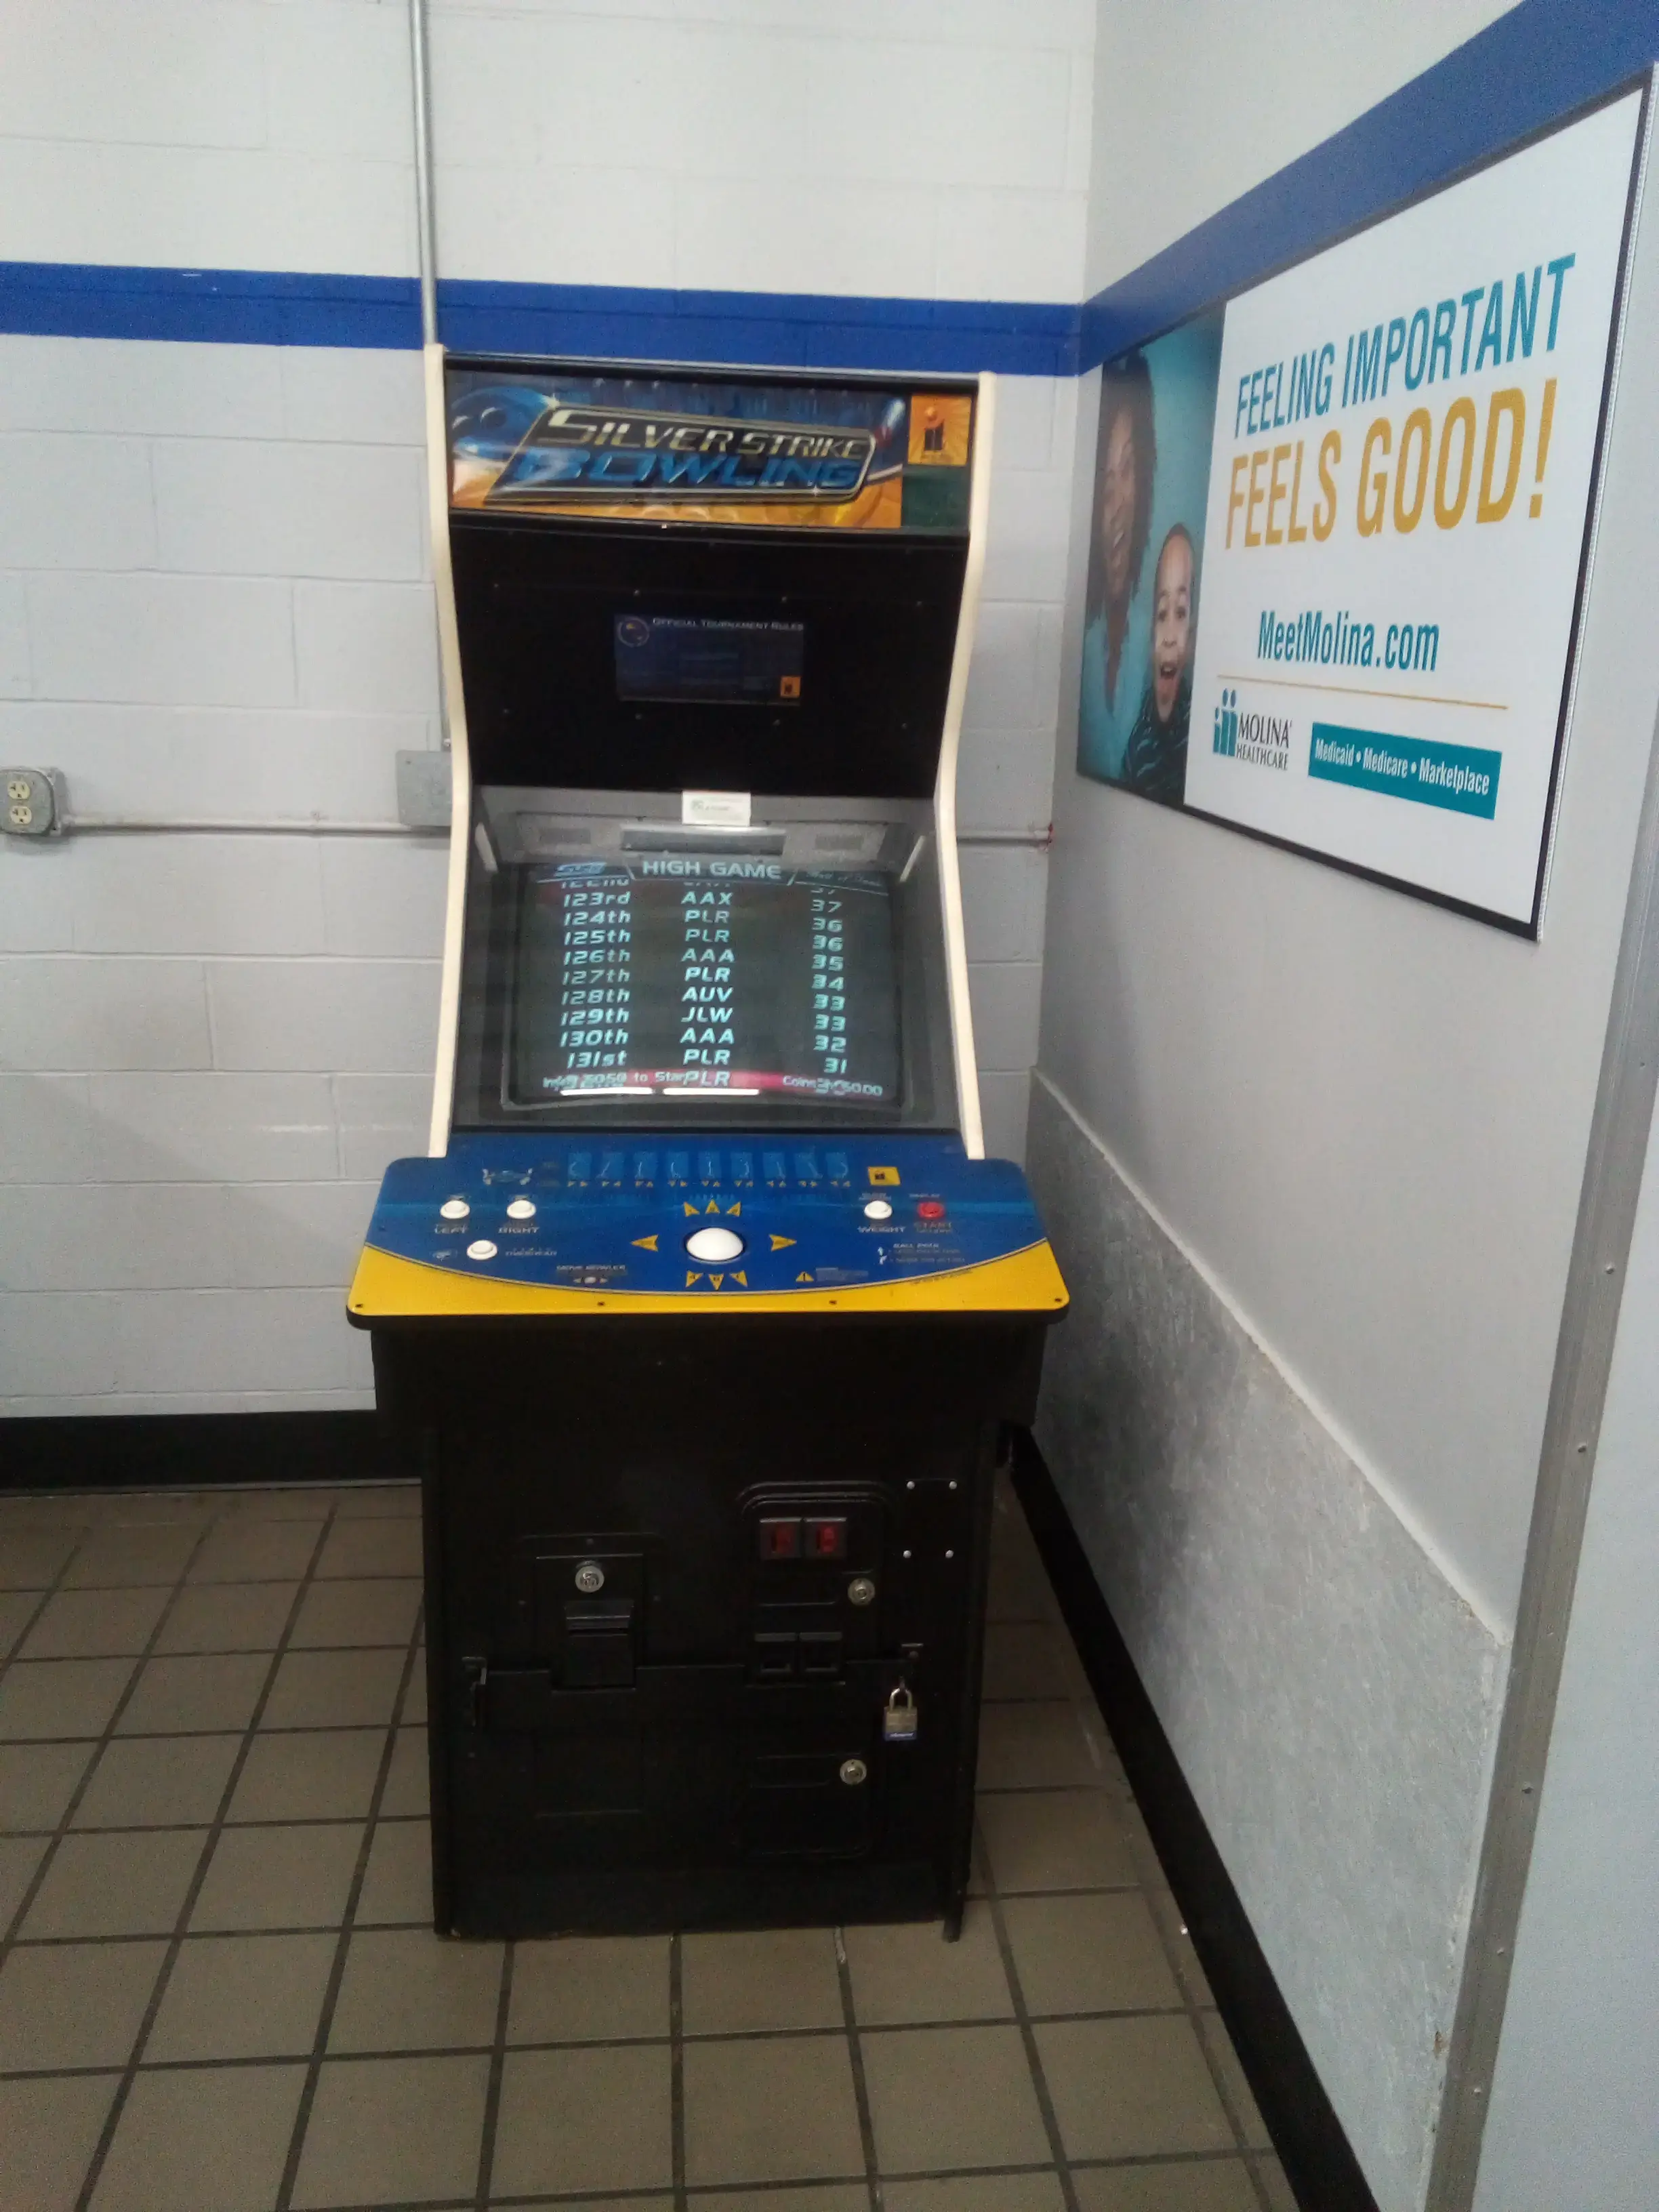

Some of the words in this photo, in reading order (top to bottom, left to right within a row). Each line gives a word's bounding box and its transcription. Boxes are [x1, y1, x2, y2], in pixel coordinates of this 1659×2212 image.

[1234, 343, 1336, 439] FEELING
[1342, 253, 1576, 409] IMPORTANT
[537, 409, 735, 453] SILVER
[740, 431, 865, 459] STRIKE
[512, 448, 862, 488] BOWLING
[1225, 430, 1341, 550] FEELS
[1355, 378, 1557, 538] GOOD!
[1258, 611, 1439, 672] MeetMolina.com
[1238, 712, 1289, 748] MOLINA
[1236, 743, 1288, 771] HEALTHCARE
[1315, 738, 1355, 766] Medicaid
[1364, 752, 1408, 778] Medicare
[1419, 762, 1490, 796] Marketplace
[642, 860, 701, 876] HIGH
[710, 861, 781, 880] GAME
[563, 890, 631, 907] 123rd
[681, 891, 732, 905] AAX
[811, 899, 842, 912] 37
[563, 910, 631, 926] 124th
[684, 910, 730, 924] PLR
[812, 918, 843, 933] 36
[564, 929, 631, 945] 125th
[684, 928, 730, 943] PLR
[813, 935, 843, 951] 36
[563, 949, 630, 965] 126th
[681, 948, 735, 962] AAA
[812, 954, 844, 971] 35
[562, 968, 630, 985] 127th
[684, 966, 731, 982] PLR
[812, 974, 844, 991] 34
[561, 989, 630, 1006] 128th
[681, 987, 733, 1002] AUV
[813, 994, 845, 1011] 33
[560, 1008, 630, 1026] 129th
[681, 1007, 733, 1023] JLW
[815, 1014, 846, 1031] 33
[560, 1028, 628, 1047] 130th
[680, 1027, 735, 1044] AAA
[813, 1035, 846, 1052] 32
[567, 1050, 627, 1069] 131st
[683, 1049, 731, 1065] PLR
[824, 1057, 847, 1074] 31
